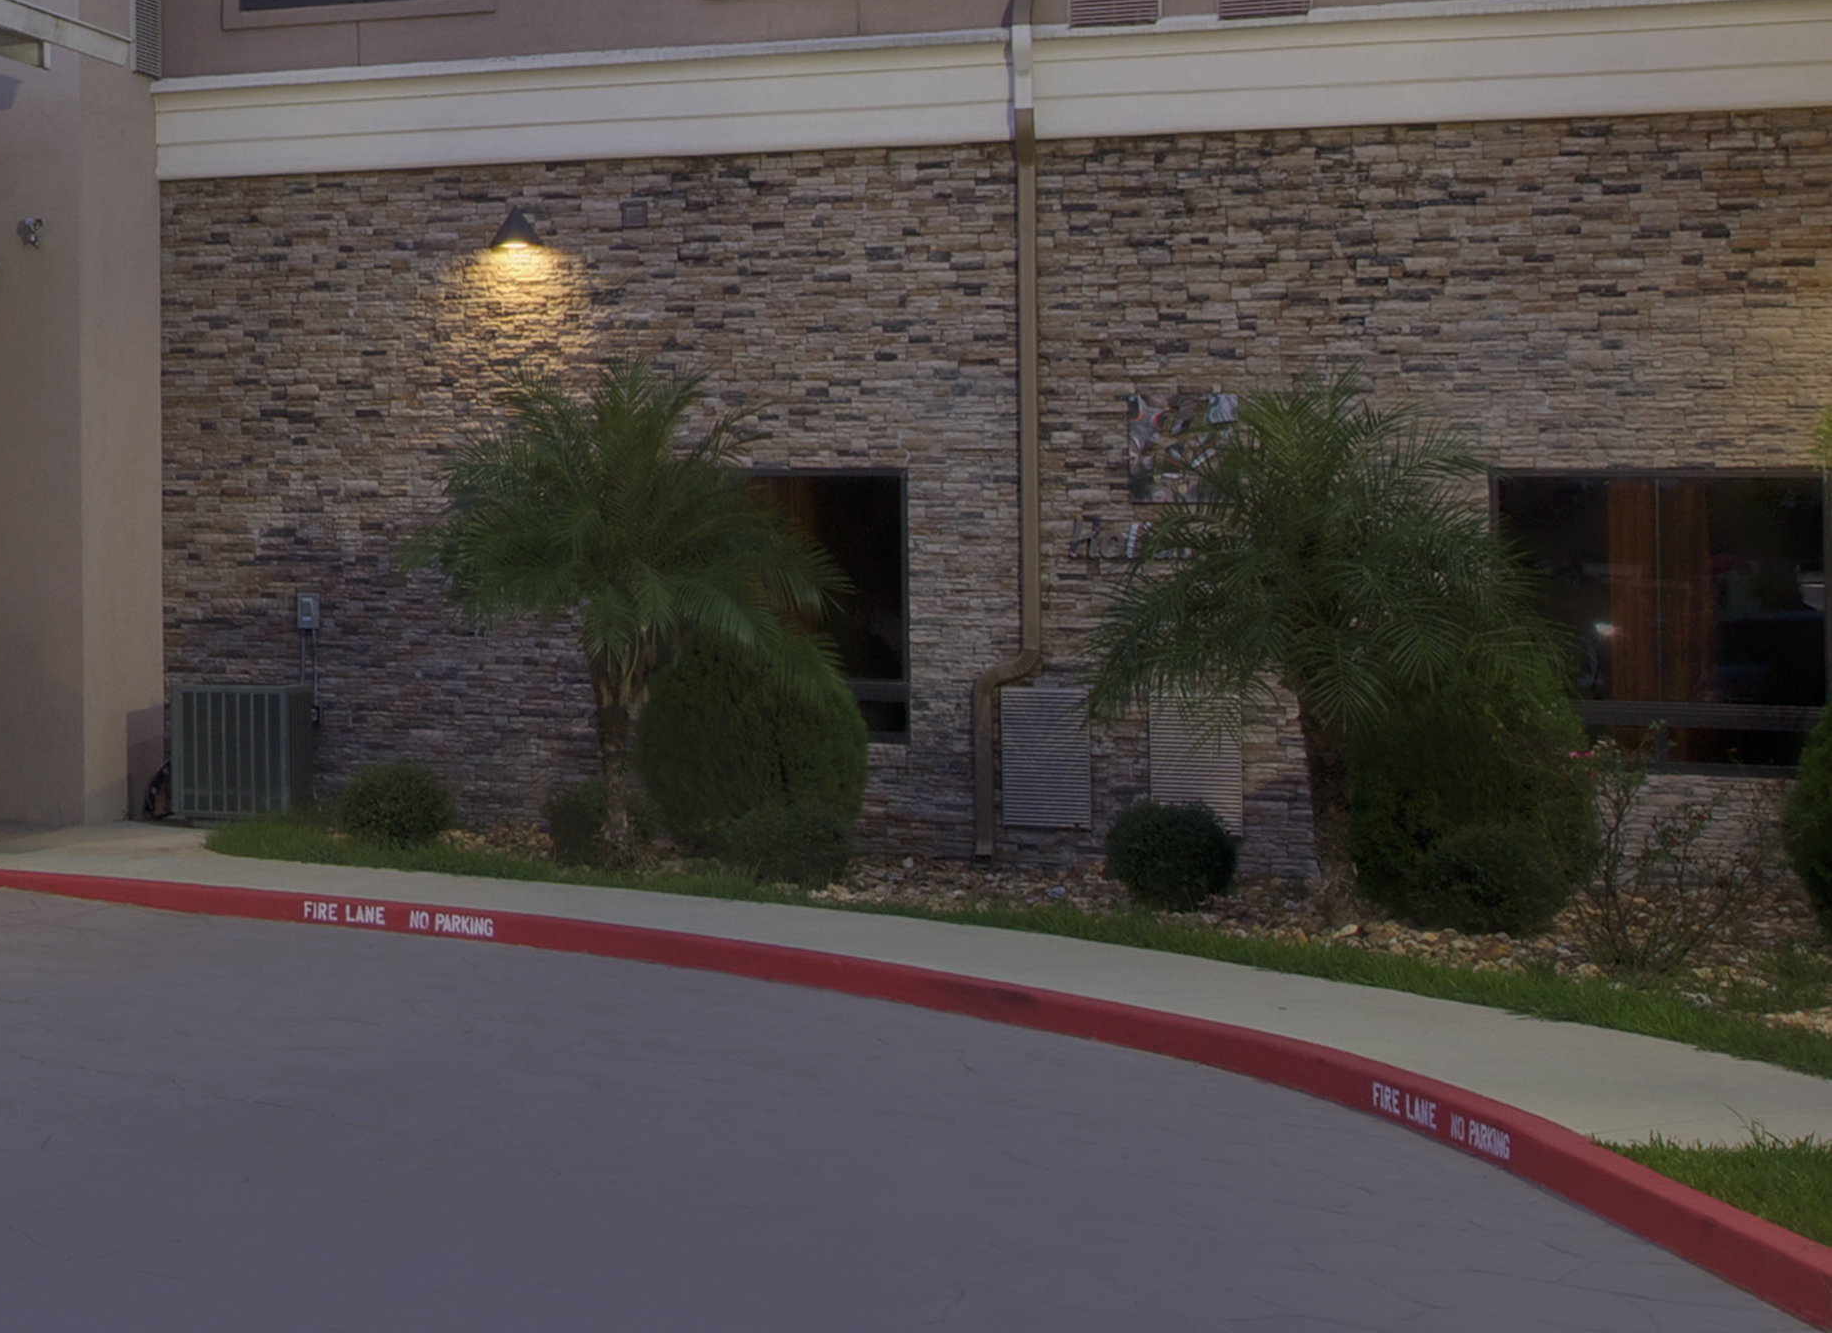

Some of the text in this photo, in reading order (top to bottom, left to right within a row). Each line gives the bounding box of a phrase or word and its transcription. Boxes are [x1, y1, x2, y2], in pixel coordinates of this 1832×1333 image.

[303, 901, 494, 937] FIRE LANE NO PARKING
[1372, 1081, 1510, 1160] FIRE LANE NO PARKING
